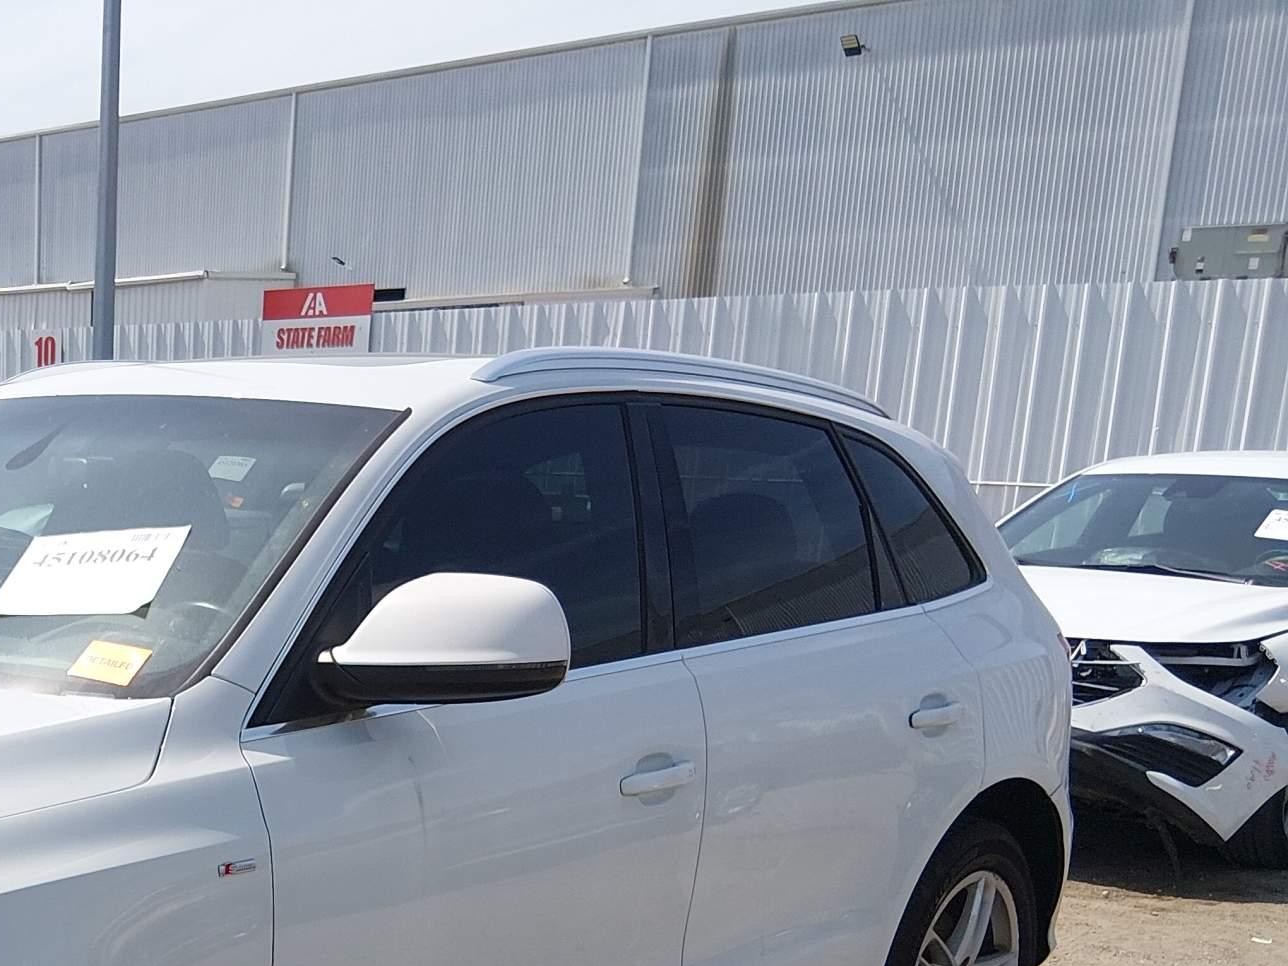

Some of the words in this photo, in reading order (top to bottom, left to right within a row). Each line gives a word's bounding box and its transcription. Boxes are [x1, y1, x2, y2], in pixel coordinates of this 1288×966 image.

[276, 327, 315, 349] STATE
[316, 325, 355, 348] FARM
[34, 336, 56, 368] 10
[32, 546, 158, 568] 45108064
